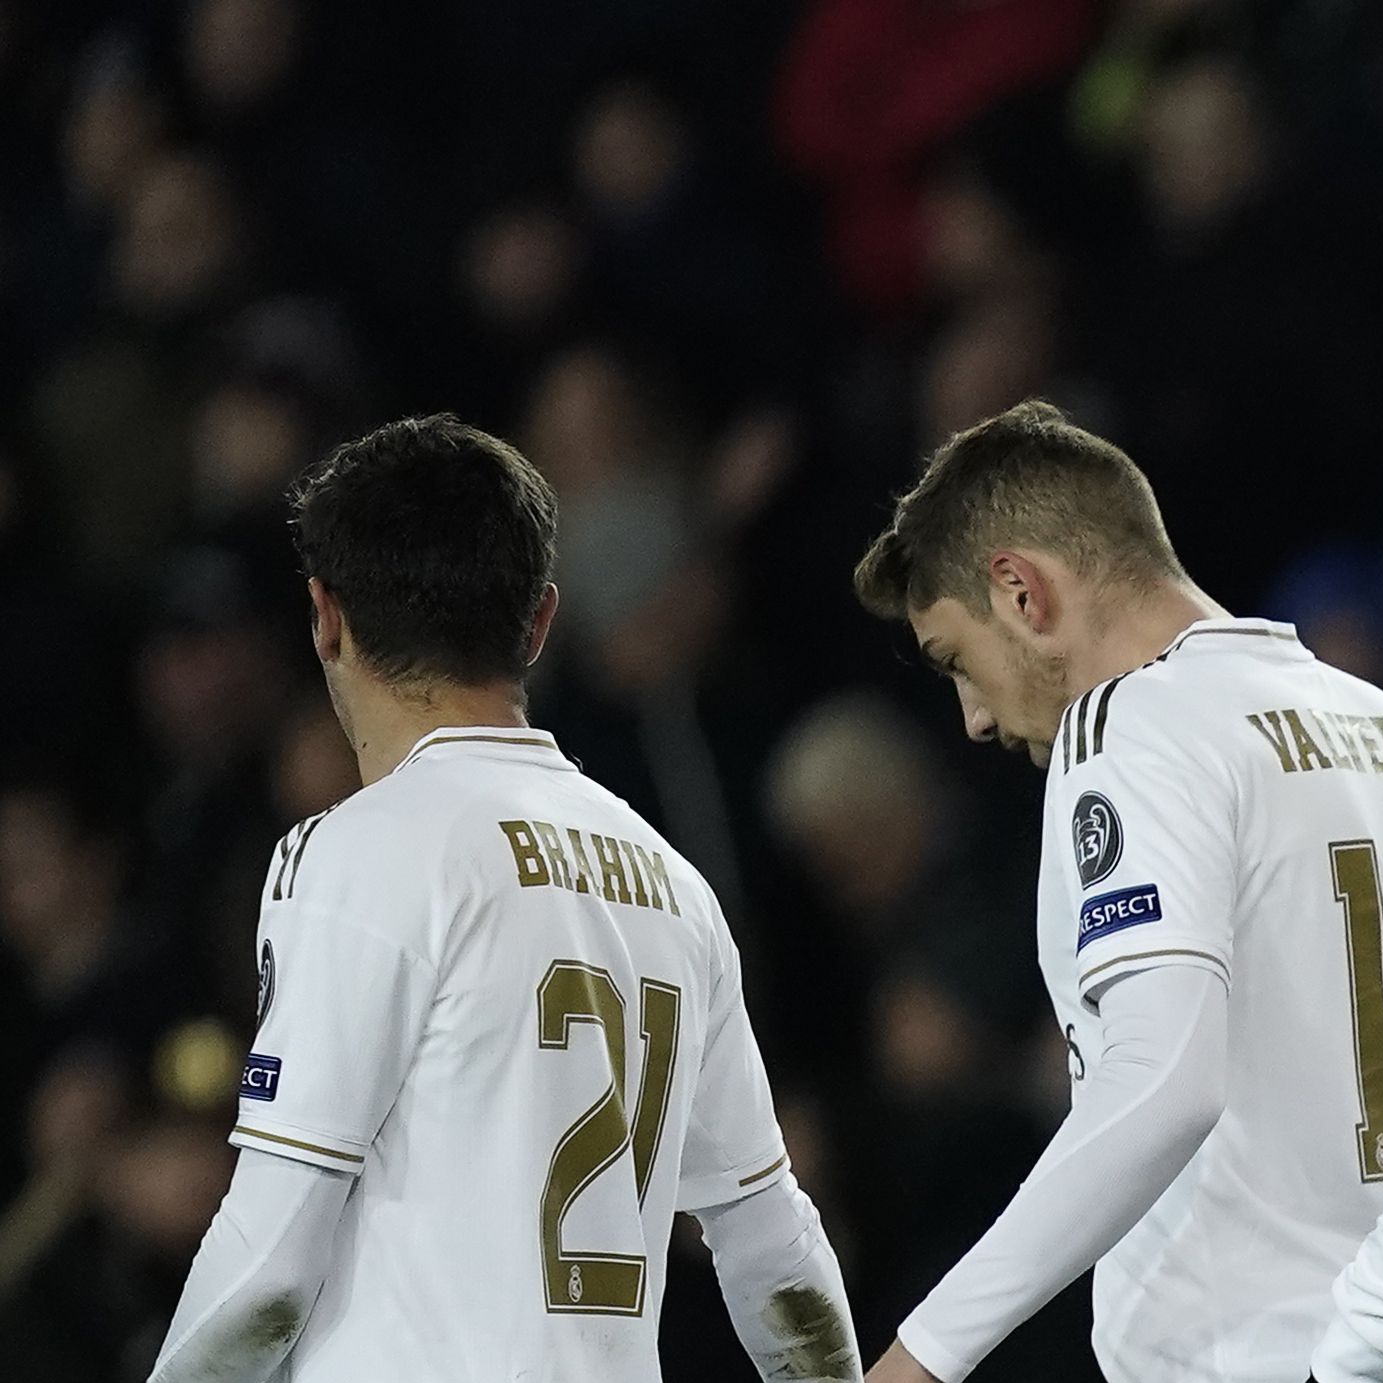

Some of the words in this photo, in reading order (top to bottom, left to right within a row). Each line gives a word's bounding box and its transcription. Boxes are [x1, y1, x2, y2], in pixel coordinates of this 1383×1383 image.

[497, 820, 681, 917] BRAHIM
[1078, 833, 1099, 867] 13
[536, 957, 681, 1318] 21
